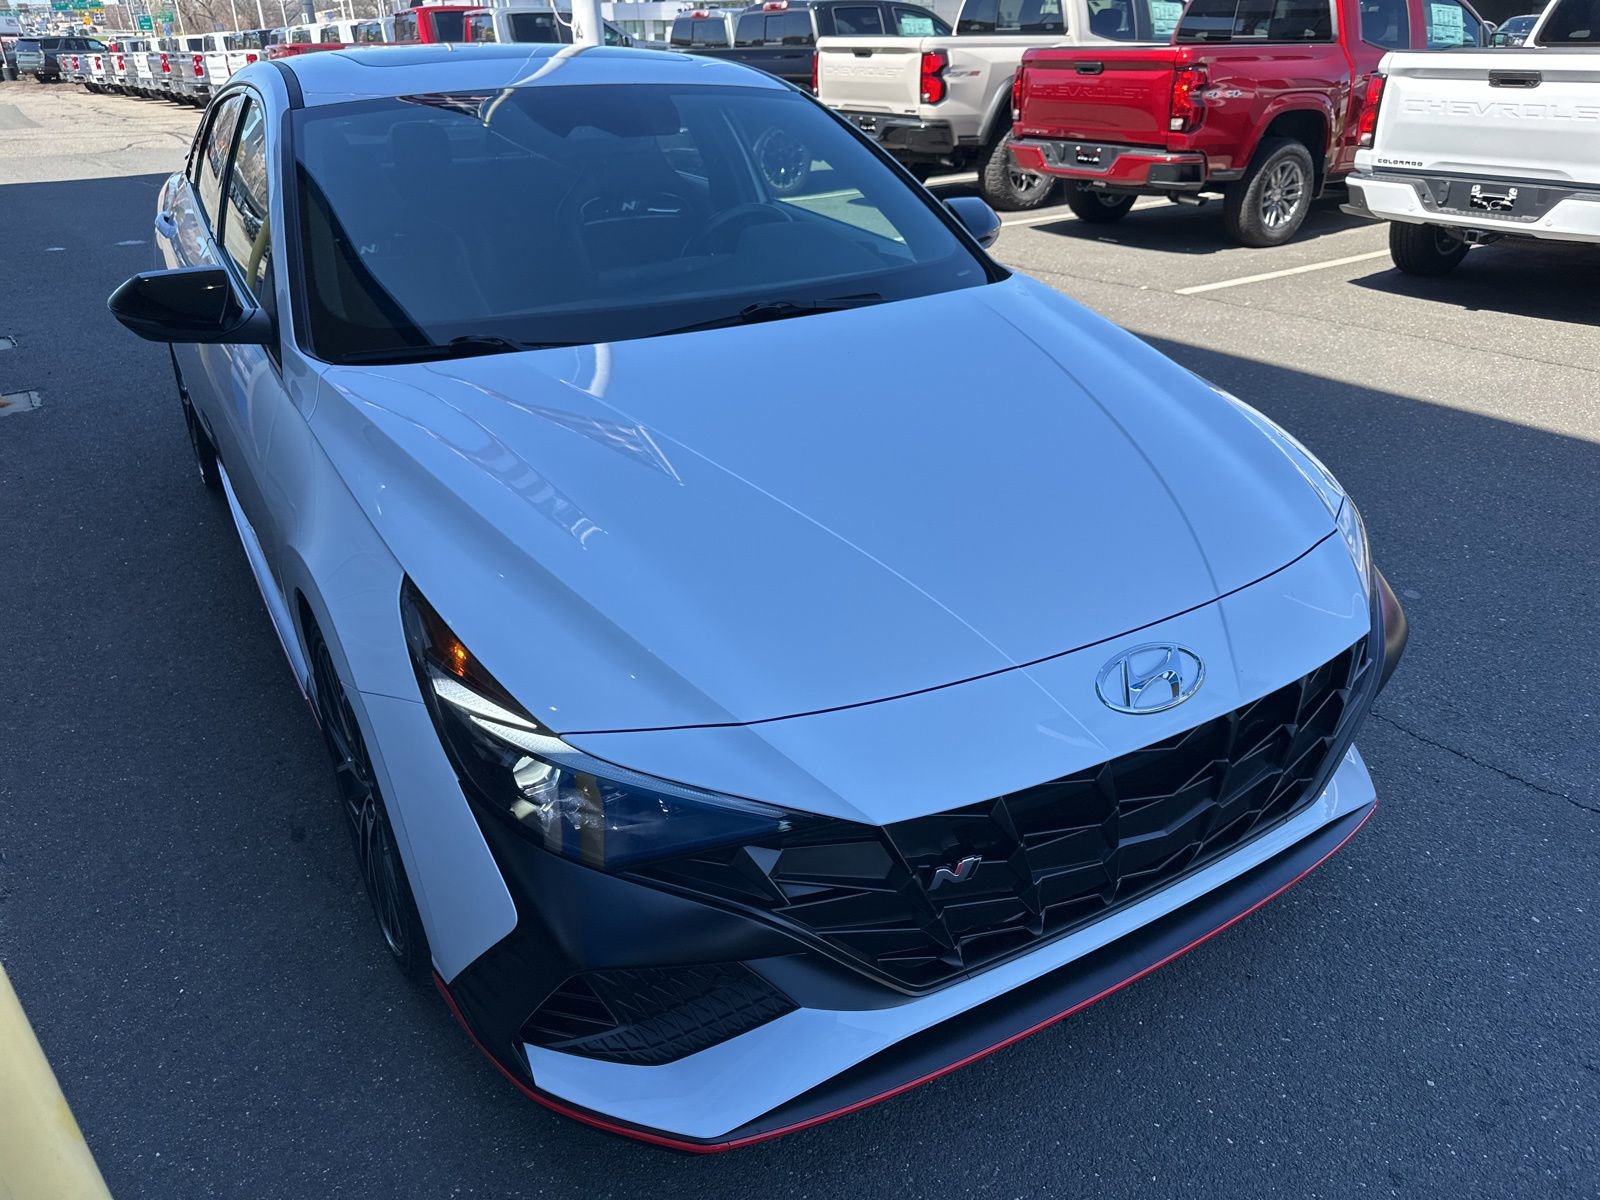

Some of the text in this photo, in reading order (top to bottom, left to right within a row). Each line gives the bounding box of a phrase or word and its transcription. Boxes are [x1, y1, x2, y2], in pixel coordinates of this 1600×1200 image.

[824, 64, 905, 80] CHEVROLET
[1032, 84, 1150, 100] CHEVROLET
[1403, 99, 1600, 122] CHEVROLE
[1377, 158, 1423, 167] COLORADO
